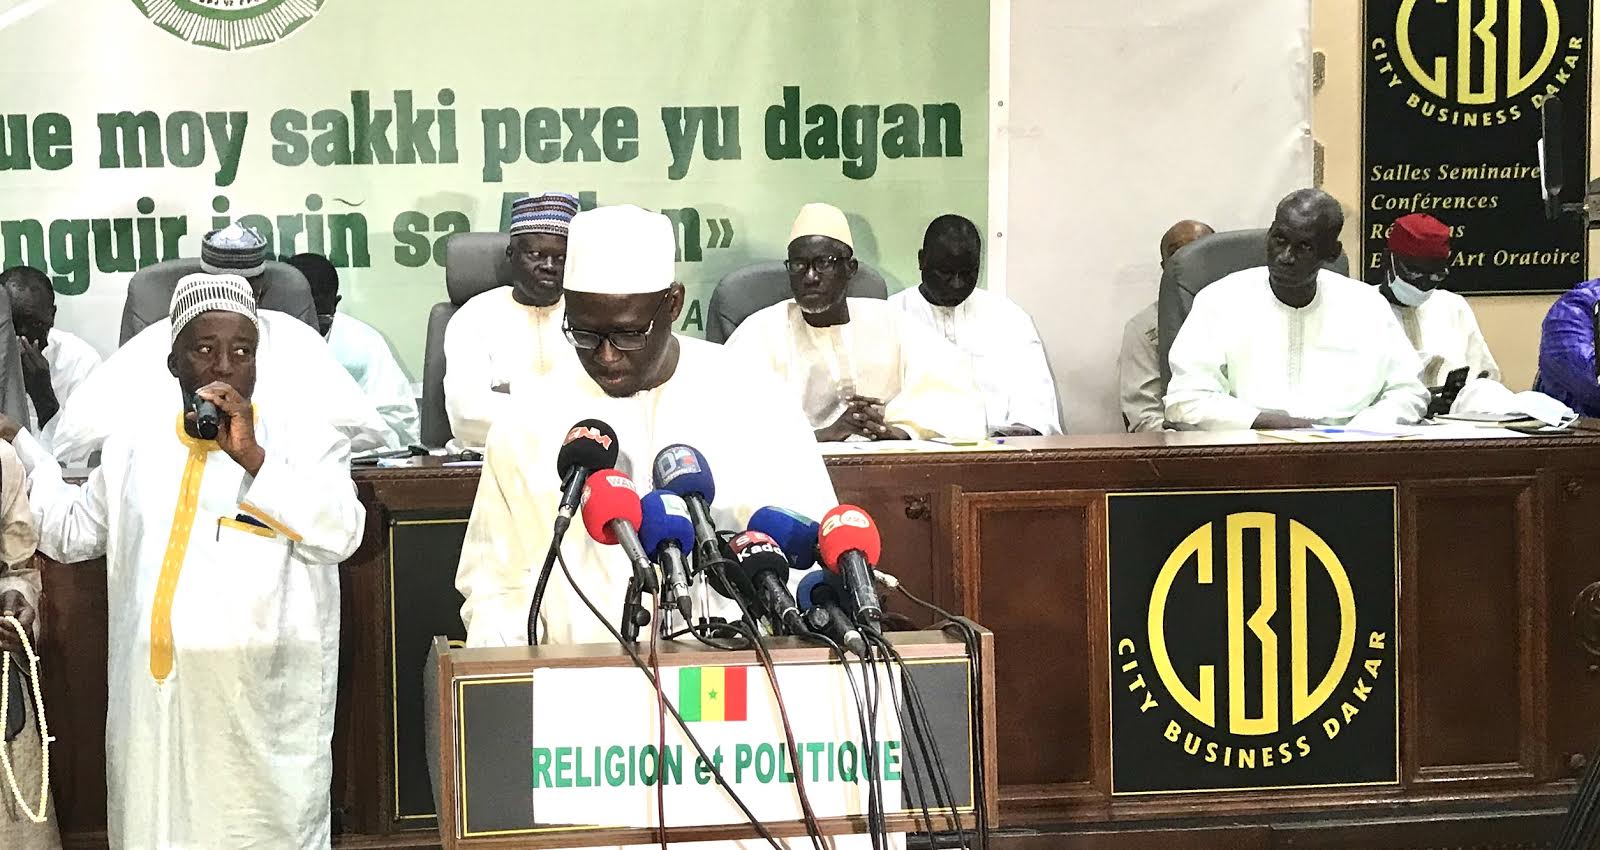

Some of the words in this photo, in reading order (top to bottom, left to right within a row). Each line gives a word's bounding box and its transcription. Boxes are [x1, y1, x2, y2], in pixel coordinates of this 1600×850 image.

[1371, 36, 1403, 90] CITY
[1406, 93, 1522, 127] BUSINESS
[1530, 36, 1584, 110] DAKAR
[1396, 0, 1560, 105] CBD
[98, 110, 249, 187] moy
[270, 88, 460, 167] sakki
[480, 104, 640, 183] pexe
[660, 105, 742, 181] yu
[764, 85, 964, 180] dagan
[1370, 163, 1431, 182] Salles
[1370, 192, 1499, 213] Conférences
[1492, 248, 1581, 267] Oratoire
[1147, 511, 1357, 737] CBD
[1117, 637, 1159, 714] CITY
[1162, 719, 1311, 769] BUSINESS
[1322, 630, 1386, 740] DAKAR
[532, 743, 683, 789] RELIGION
[694, 745, 725, 785] et
[735, 740, 902, 786] POLITIQUE
